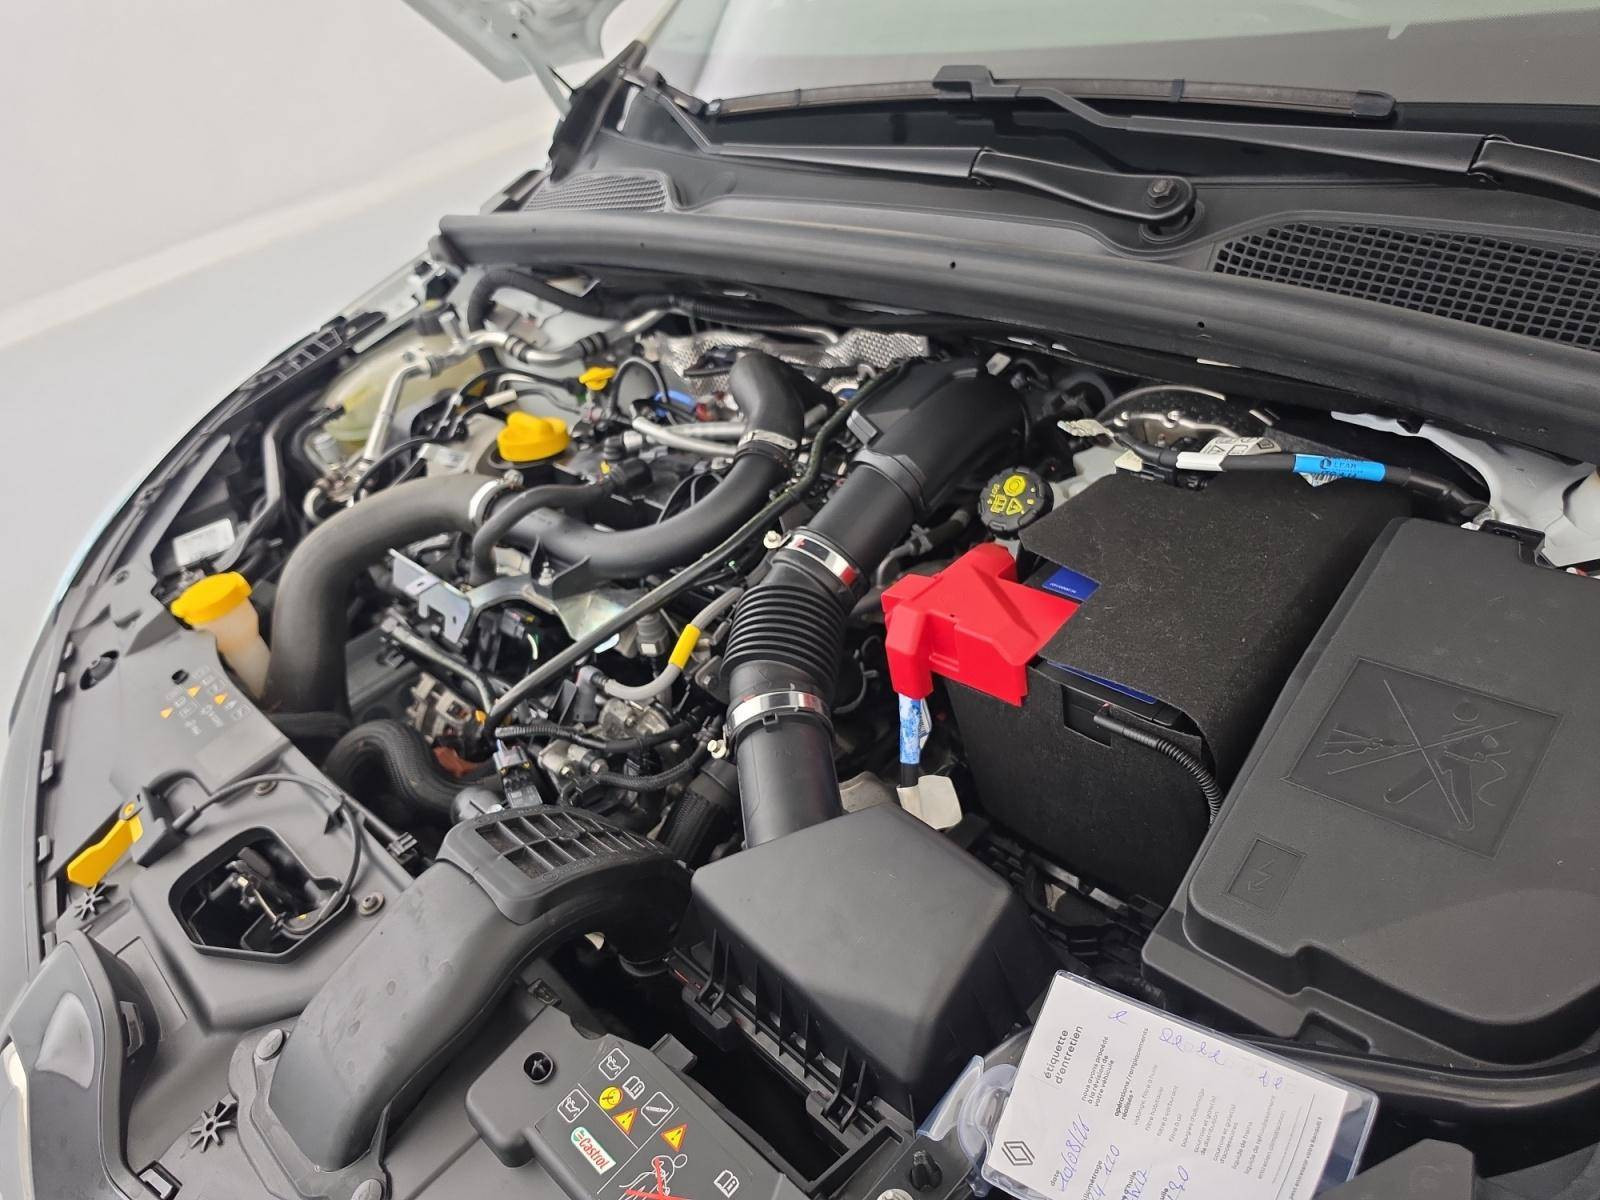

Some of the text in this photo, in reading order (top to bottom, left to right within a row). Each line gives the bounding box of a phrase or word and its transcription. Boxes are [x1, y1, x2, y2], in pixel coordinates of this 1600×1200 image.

[1044, 1030, 1069, 1079] étiquette
[1056, 1025, 1083, 1084] d'entretien
[1101, 1054, 1109, 1063] de
[1080, 1083, 1091, 1101] nous
[1087, 1062, 1098, 1083] avons
[1093, 1059, 1114, 1106] votre véhicule
[579, 1138, 610, 1169] Castrol
[1050, 1169, 1060, 1185] date
